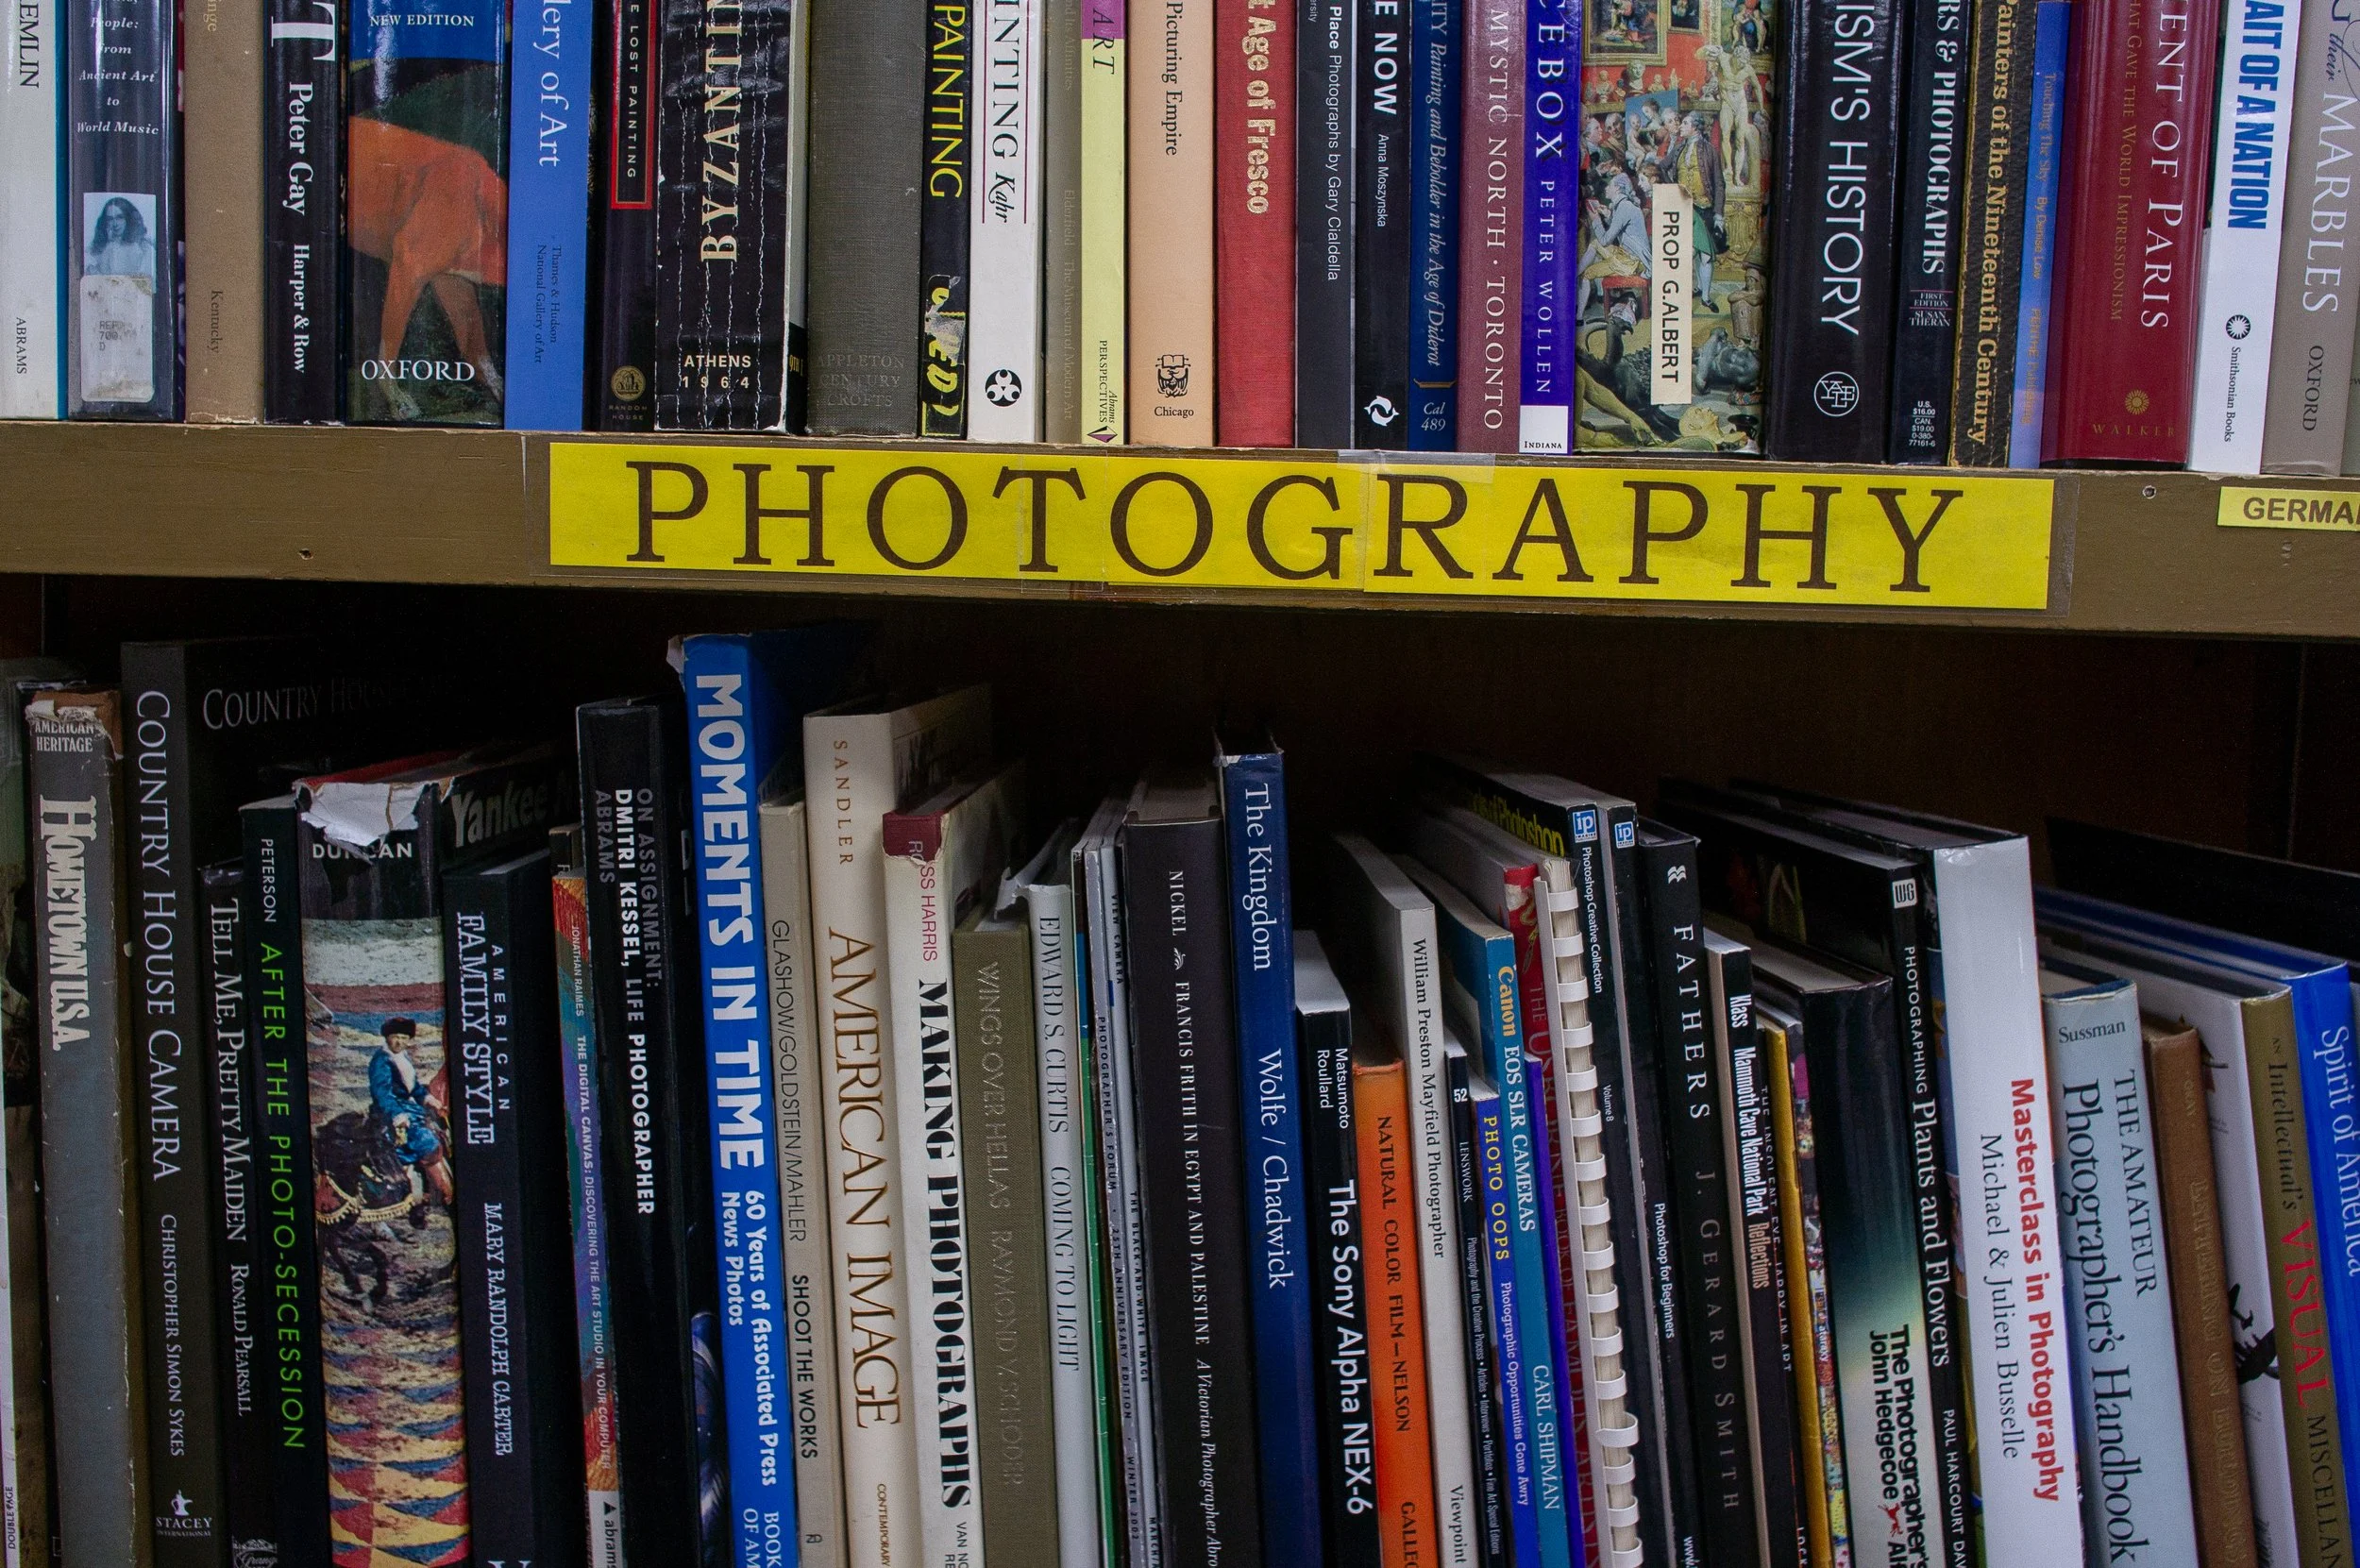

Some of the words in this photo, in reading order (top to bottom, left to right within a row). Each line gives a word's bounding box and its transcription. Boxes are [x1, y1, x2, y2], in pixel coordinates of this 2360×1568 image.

[370, 14, 398, 25] NEW
[406, 14, 474, 26] EDITION
[629, 25, 639, 74] LOST
[1092, 9, 1115, 75] ART
[1162, 1, 1183, 86] Picturing
[1242, 18, 1276, 73] Age
[1328, 6, 1342, 49] Place
[1246, 79, 1276, 111] of
[1374, 32, 1398, 116] NOW
[1425, 42, 1447, 106] Painting
[1488, 9, 1509, 123] MYSTIC
[2239, 50, 2280, 92] OF
[289, 82, 313, 153] Peter
[627, 86, 637, 178] PAINTING
[930, 5, 966, 199] PAINTING
[1162, 90, 1183, 156] Empire
[1325, 55, 1342, 149] Photographs
[1430, 109, 1447, 142] and
[1991, 106, 2011, 129] of
[2237, 94, 2275, 116] A
[1246, 119, 1276, 214] Fresco
[1325, 154, 1341, 172] by
[1377, 134, 1389, 163] Anna
[1429, 144, 1446, 208] Beholder
[1922, 71, 1957, 275] PHOTOGRAPHS
[1988, 137, 2011, 179] the
[2151, 122, 2182, 179] OF
[2227, 117, 2274, 229] NATION
[283, 161, 313, 216] Gay
[988, 172, 1016, 223] Kahr
[1324, 177, 1341, 212] Gary
[1377, 167, 1389, 228] Moszynska
[1429, 212, 1445, 228] in
[1487, 138, 1508, 248] NORTH
[1540, 180, 1555, 263] PETER
[2302, 93, 2357, 314] MARBLES
[1327, 216, 1341, 280] Cialdella
[1429, 233, 1446, 255] the
[1662, 211, 1679, 271] PROP
[1821, 140, 1868, 335] HISTORY
[1979, 184, 2008, 332] Nineteenth
[2141, 198, 2183, 329] PARIS
[290, 244, 310, 308] Harper
[1424, 259, 1445, 288] Age
[1424, 291, 1445, 310] of
[16, 317, 26, 374] ABRAMS
[294, 314, 310, 333] &
[294, 336, 310, 374] Row
[1427, 310, 1445, 367] Diderot
[1484, 275, 1506, 430] TORONTO
[1537, 280, 1553, 393] WOLLEN
[362, 359, 475, 382] OXFORD
[683, 355, 751, 368] ATHENS
[1099, 340, 1108, 423] PERSPECTIVES
[1968, 339, 1998, 445] Century
[2226, 346, 2241, 408] Smithsonian
[2302, 346, 2325, 431] OXFORD
[1155, 406, 1194, 419] Chicago
[1421, 418, 1446, 431] 489
[1423, 402, 1445, 416] Cal
[1912, 425, 1934, 433] $19.00
[1913, 408, 1935, 416] $16.00
[2223, 412, 2238, 443] Books
[626, 461, 1963, 593] PHOTOGRAPHY
[615, 789, 636, 872] DMITRI
[696, 674, 754, 946] MOMENTS
[834, 740, 853, 864] SANDLER
[1244, 784, 1272, 839] The
[261, 838, 276, 923] PETERSON
[1242, 844, 1277, 971] Kingdom
[1582, 847, 1595, 902] Photoshop
[919, 894, 938, 962] HARRIS
[1587, 902, 1597, 943] Creative
[260, 942, 286, 1039] AFTER
[624, 977, 644, 1021] LIFE
[711, 967, 759, 1021] IN
[1039, 916, 1066, 1017] EDWARD
[1413, 937, 1427, 1003] William
[1591, 944, 1603, 994] Collection
[1043, 1023, 1066, 1040] S.
[1498, 966, 1516, 1037] Canon
[1672, 923, 1711, 1120] FATHERS
[1903, 946, 1928, 1094] PHOTOGRAPHING
[2058, 1020, 2126, 1043] Sussman
[919, 978, 956, 1161] MAKING
[1418, 1008, 1431, 1069] Preston
[1504, 1045, 1523, 1087] EOS
[266, 1058, 290, 1116] THE
[715, 1037, 765, 1171] TIME
[829, 925, 891, 1228] AMERICAN
[1044, 1045, 1070, 1134] CURTIS
[1257, 1048, 1289, 1127] Wolfe
[1316, 1049, 1331, 1109] Roullard
[1335, 1048, 1350, 1129] Matsumoto
[1454, 1088, 1468, 1103] 52
[2114, 1069, 2141, 1134] THE
[628, 1034, 655, 1215] PHOTOGRAPHER
[1421, 1073, 1441, 1147] Mayfield
[1507, 1091, 1526, 1131] SLR
[1484, 1116, 1503, 1191] PHOTO
[1912, 1101, 1939, 1187] Plants
[2011, 1079, 2043, 1267] Masterclass
[745, 1190, 766, 1220] 60
[1050, 1165, 1075, 1258] COMING
[1328, 1179, 1358, 1236] The
[1425, 1151, 1446, 1258] Photographer
[1511, 1135, 1535, 1232] CAMERAS
[1981, 1134, 2002, 1238] Michael
[721, 1192, 741, 1248] News
[1262, 1155, 1293, 1289] Chadwick
[1491, 1203, 1510, 1259] OOPS
[1919, 1195, 1946, 1254] and
[2121, 1144, 2156, 1299] AMATEUR
[745, 1224, 766, 1284] Years
[1054, 1264, 1076, 1296] TO
[1327, 1234, 1359, 1320] Sony
[1988, 1247, 2010, 1270] &
[2025, 1273, 2051, 1301] in
[725, 1254, 743, 1327] Photos
[750, 1288, 770, 1312] of
[792, 1275, 811, 1343] SHOOT
[1925, 1260, 1949, 1368] Flowers
[1982, 1276, 2012, 1350] Julien
[2280, 1219, 2331, 1408] VISUAL
[795, 1348, 813, 1383] THE
[846, 1252, 902, 1429] IMAGE
[928, 1173, 972, 1509] PHOTOGRAPHS
[1054, 1300, 1080, 1372] LIGHT
[1870, 1331, 1890, 1385] John
[751, 1316, 778, 1427] Associated
[1331, 1326, 1368, 1413] Alpha
[1532, 1365, 1552, 1417] CARL
[798, 1389, 818, 1459] WORKS
[1996, 1360, 2024, 1459] Busselle
[2027, 1310, 2065, 1502] Photography
[757, 1432, 780, 1487] Press
[1342, 1422, 1374, 1515] NEX-6
[1537, 1422, 1559, 1510] SHIPMAN
[1873, 1389, 1898, 1501] Hedgecoe
[2092, 1364, 2149, 1563] Handbook
[1449, 1485, 1466, 1565] Viewpoint
